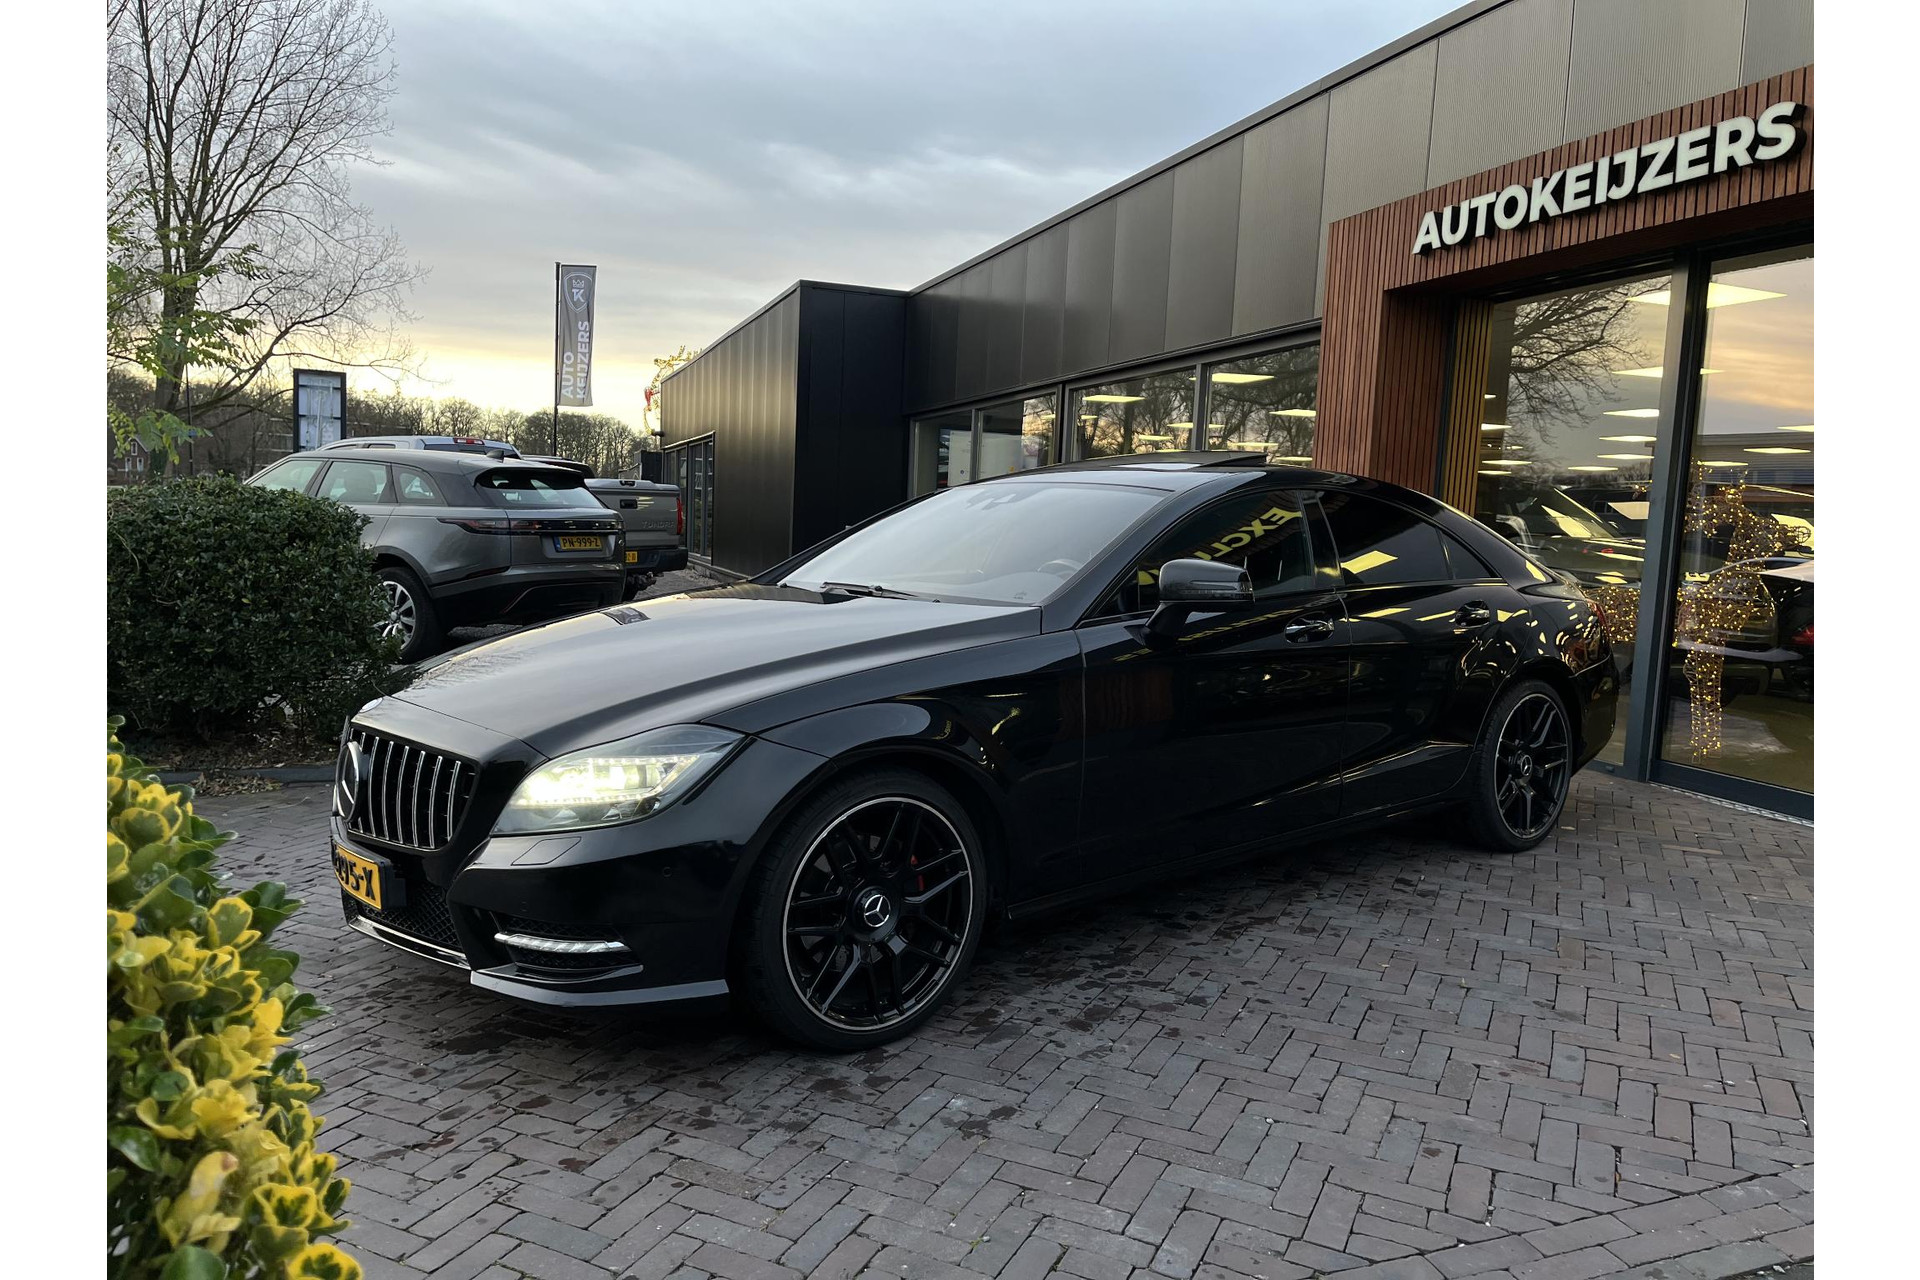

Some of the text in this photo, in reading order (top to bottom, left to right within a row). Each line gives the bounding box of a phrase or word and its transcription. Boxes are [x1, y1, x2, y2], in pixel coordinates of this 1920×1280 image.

[1412, 101, 1798, 255] AUTOKEIJZERS
[561, 351, 574, 399] AUTO
[576, 320, 590, 400] KEIJZERS
[562, 537, 600, 548] PN-999-Z
